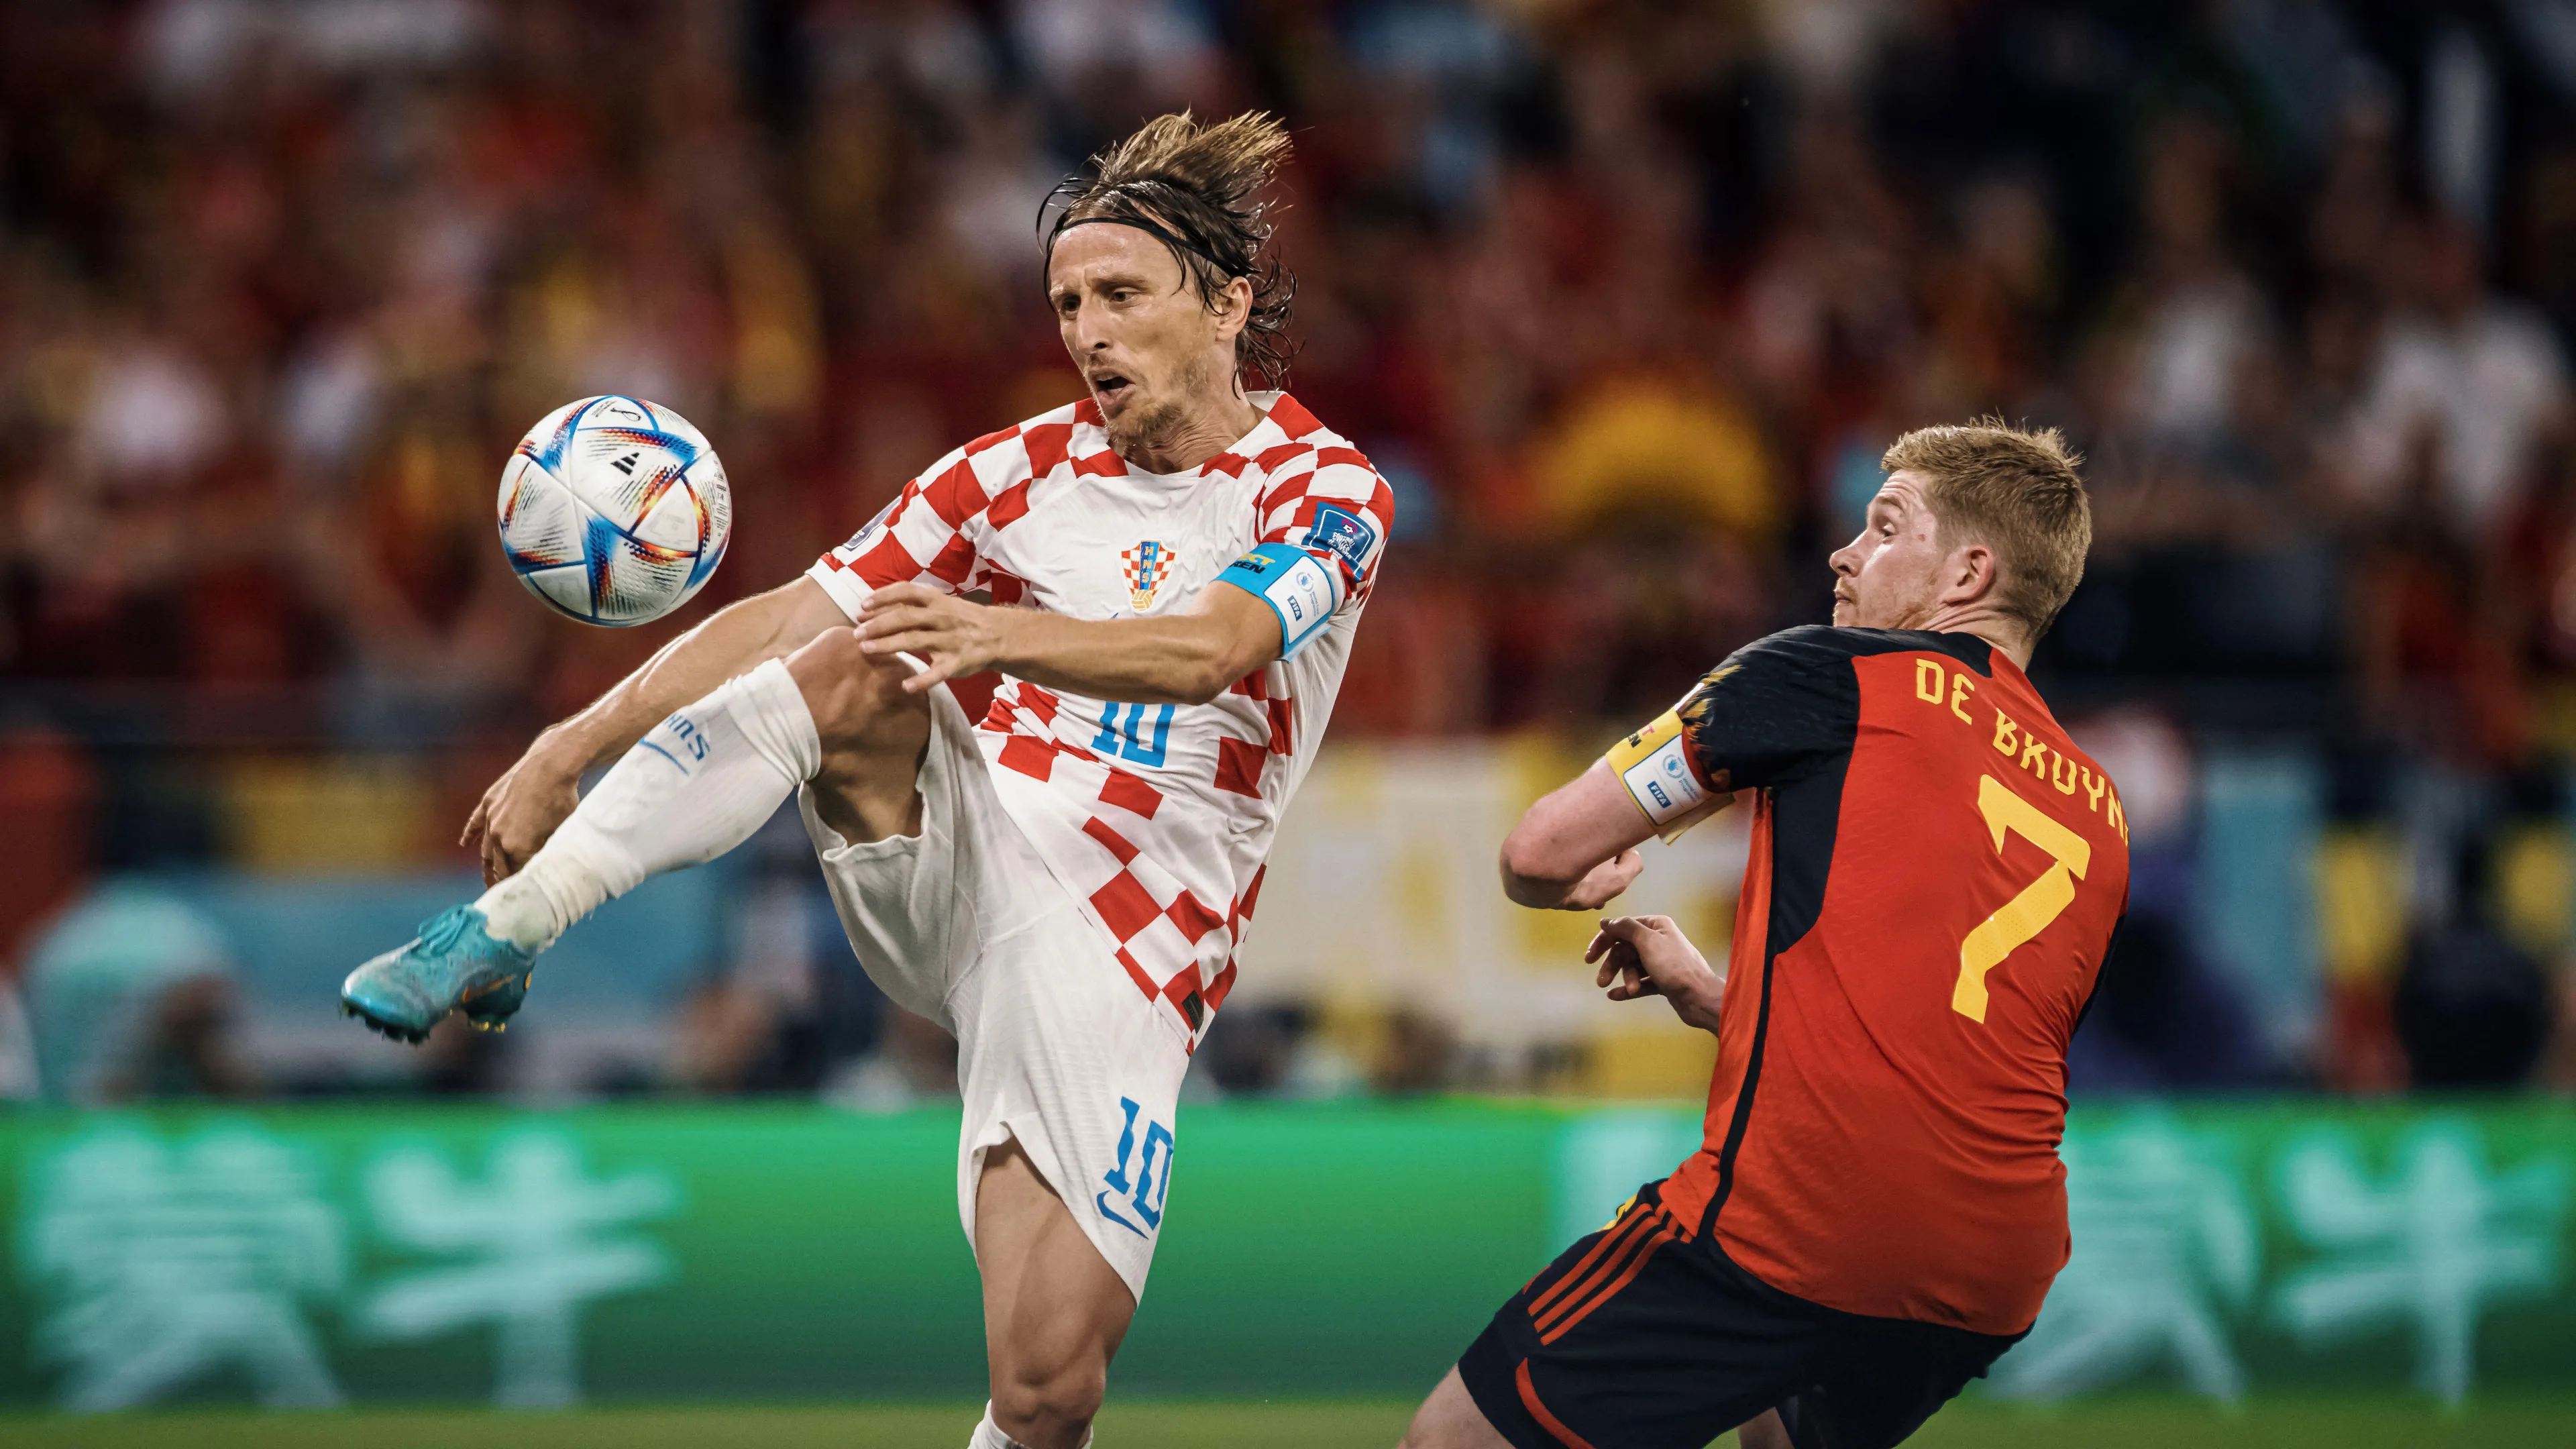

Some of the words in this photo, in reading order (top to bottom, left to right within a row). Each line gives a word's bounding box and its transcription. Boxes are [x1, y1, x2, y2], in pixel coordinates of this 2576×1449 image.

[1141, 545, 1155, 583] HNS
[1289, 597, 1301, 619] FIFA
[1916, 658, 1975, 725] DE
[1091, 702, 1175, 768] 10
[1650, 784, 1668, 806] FIFA
[1952, 773, 2090, 1024] 7
[1104, 1095, 1174, 1231] 10
